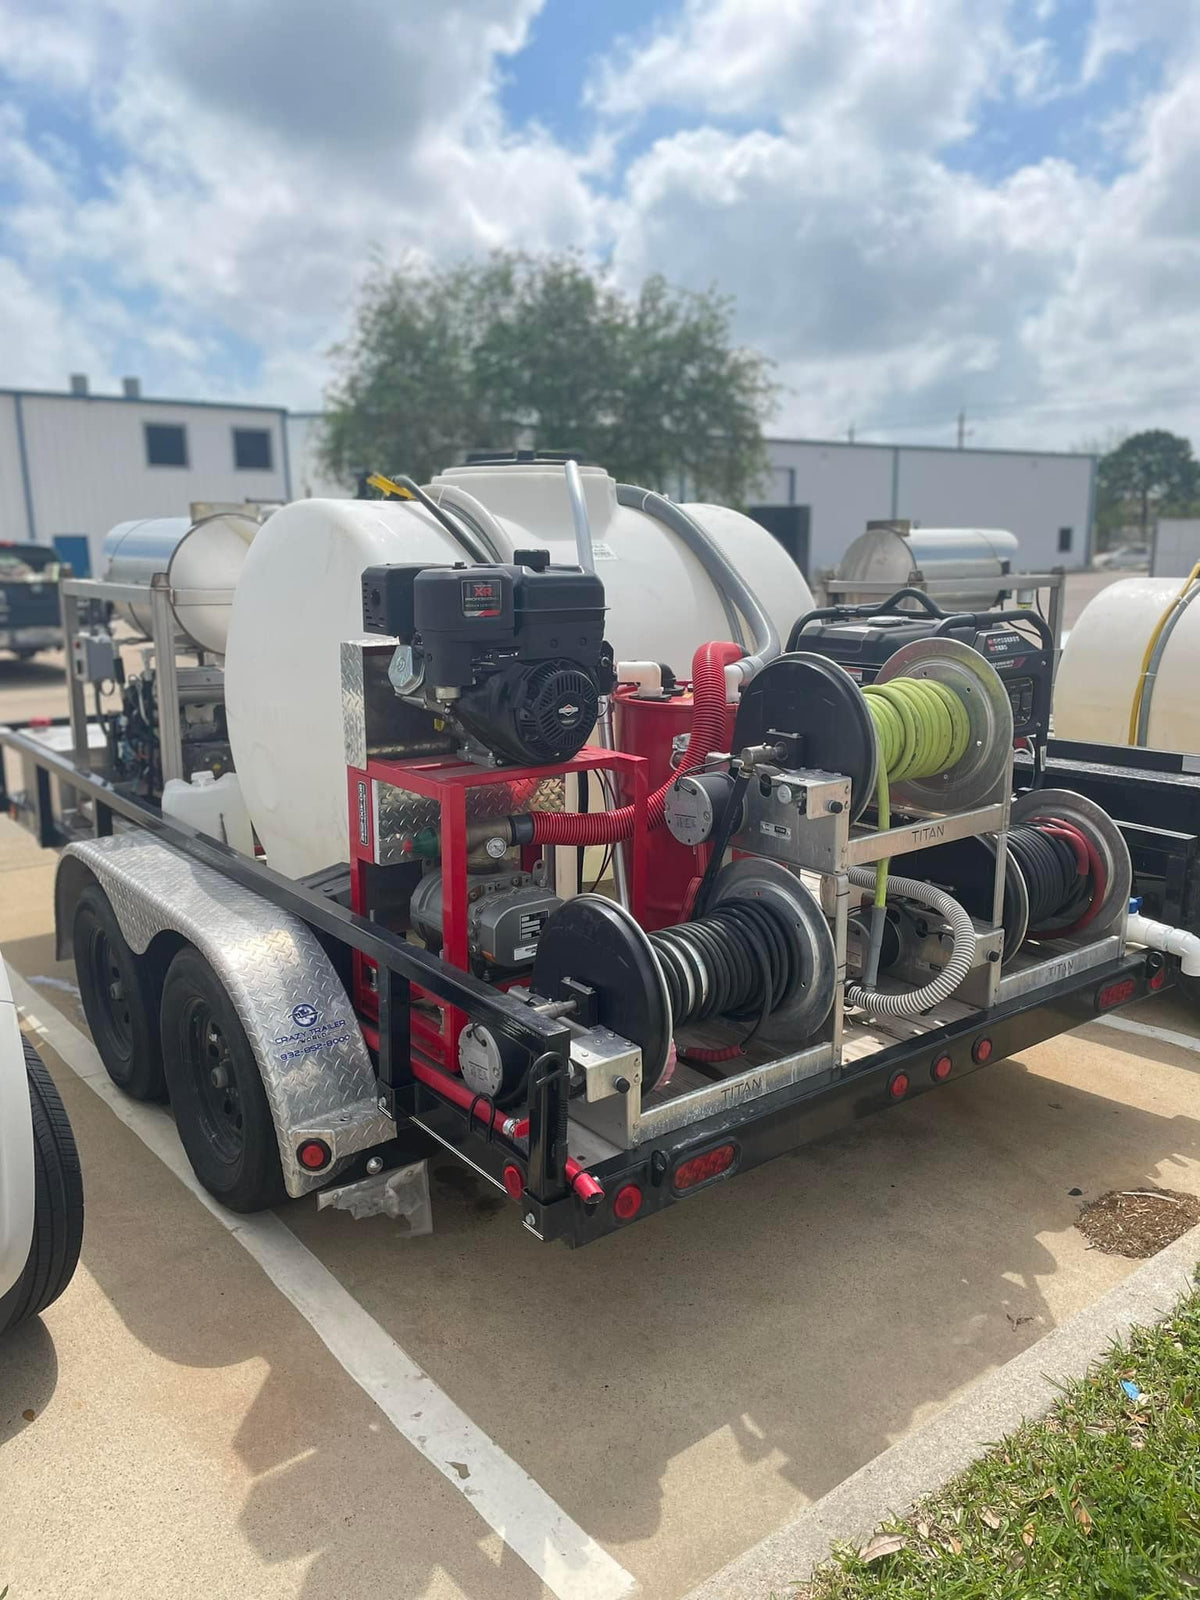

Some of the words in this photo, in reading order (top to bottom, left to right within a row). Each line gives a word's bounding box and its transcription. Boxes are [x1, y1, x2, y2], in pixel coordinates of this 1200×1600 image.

[474, 587, 493, 597] XR
[911, 824, 945, 843] TITAN
[1048, 960, 1073, 977] TITAN
[275, 1032, 306, 1045] CRAZY
[309, 1019, 346, 1035] TRAILER
[300, 1032, 327, 1043] WORLD
[280, 1034, 350, 1061] 832-852-8000
[721, 1076, 762, 1101] TITAN
